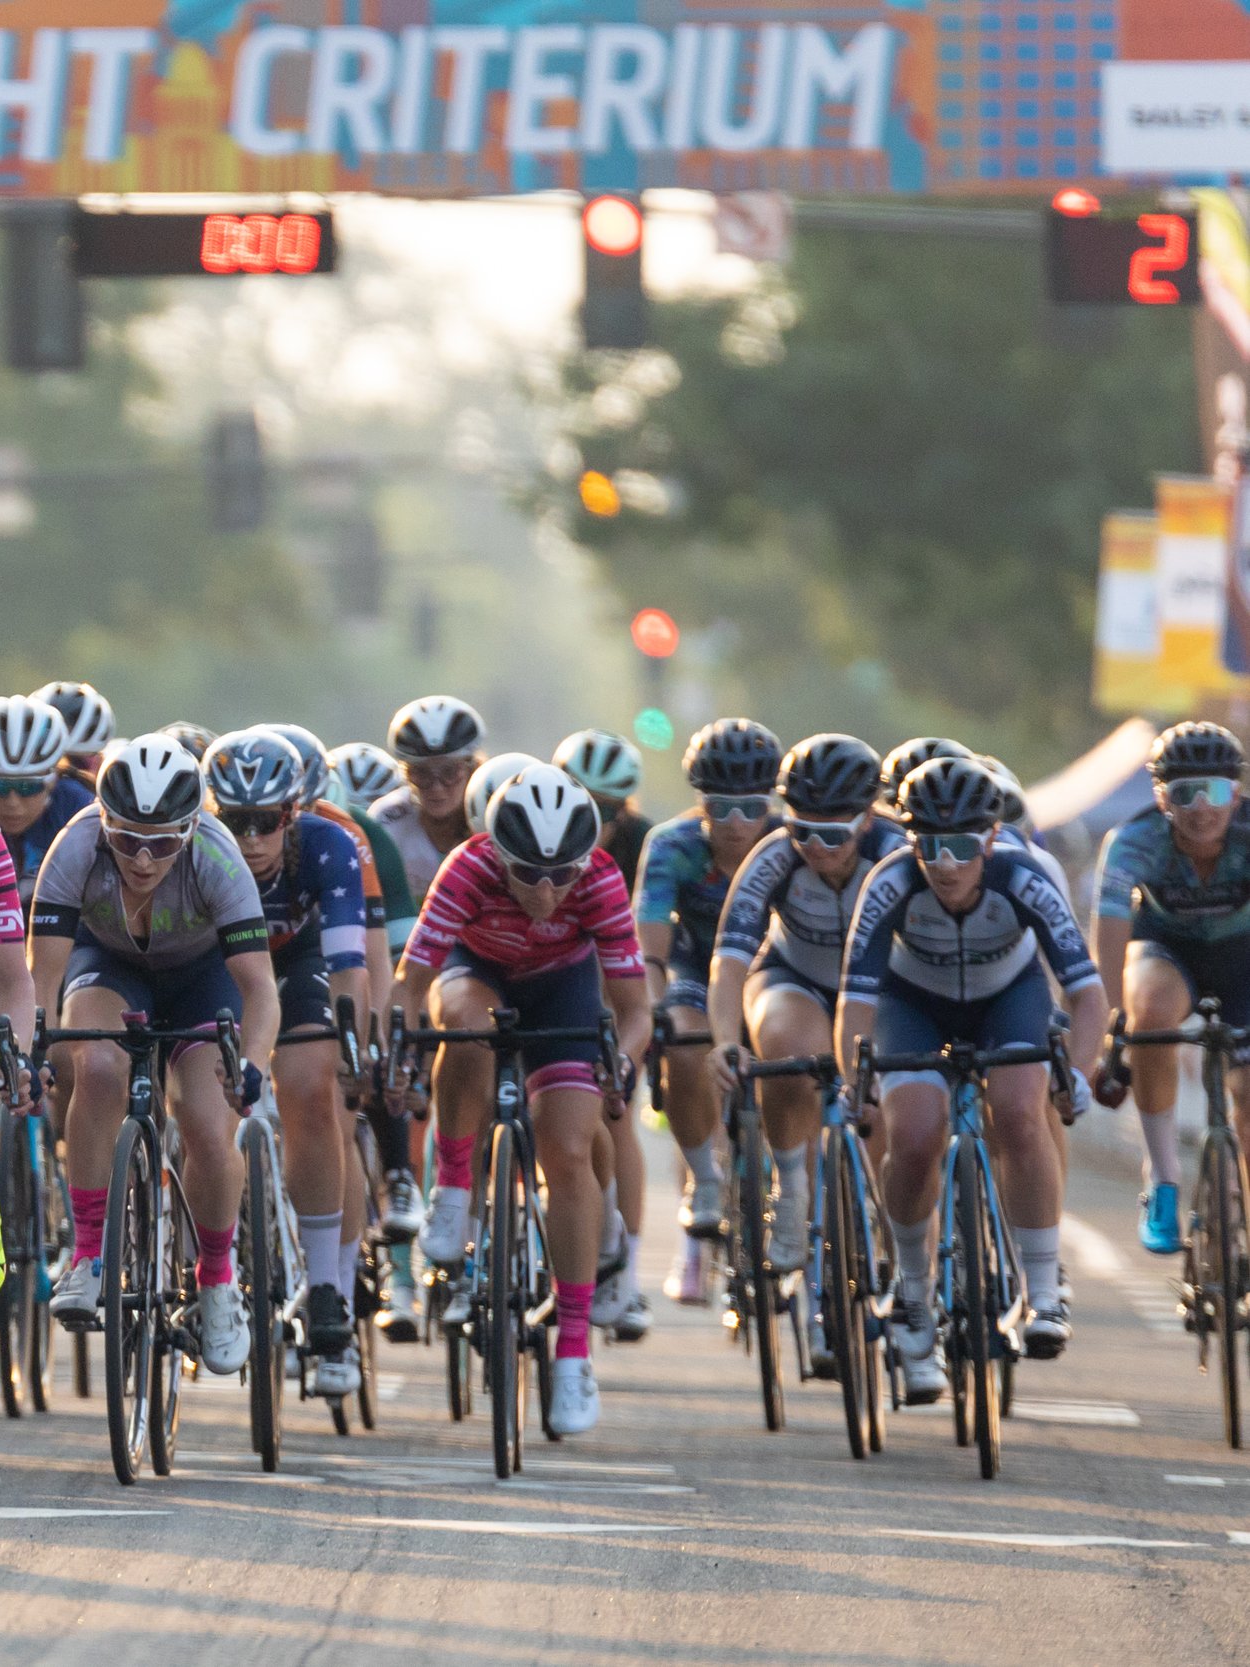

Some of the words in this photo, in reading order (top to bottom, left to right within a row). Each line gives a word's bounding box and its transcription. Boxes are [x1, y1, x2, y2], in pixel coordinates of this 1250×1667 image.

[230, 22, 896, 155] CRITERIUM
[1127, 213, 1190, 305] 2
[225, 929, 254, 943] YOUNG
